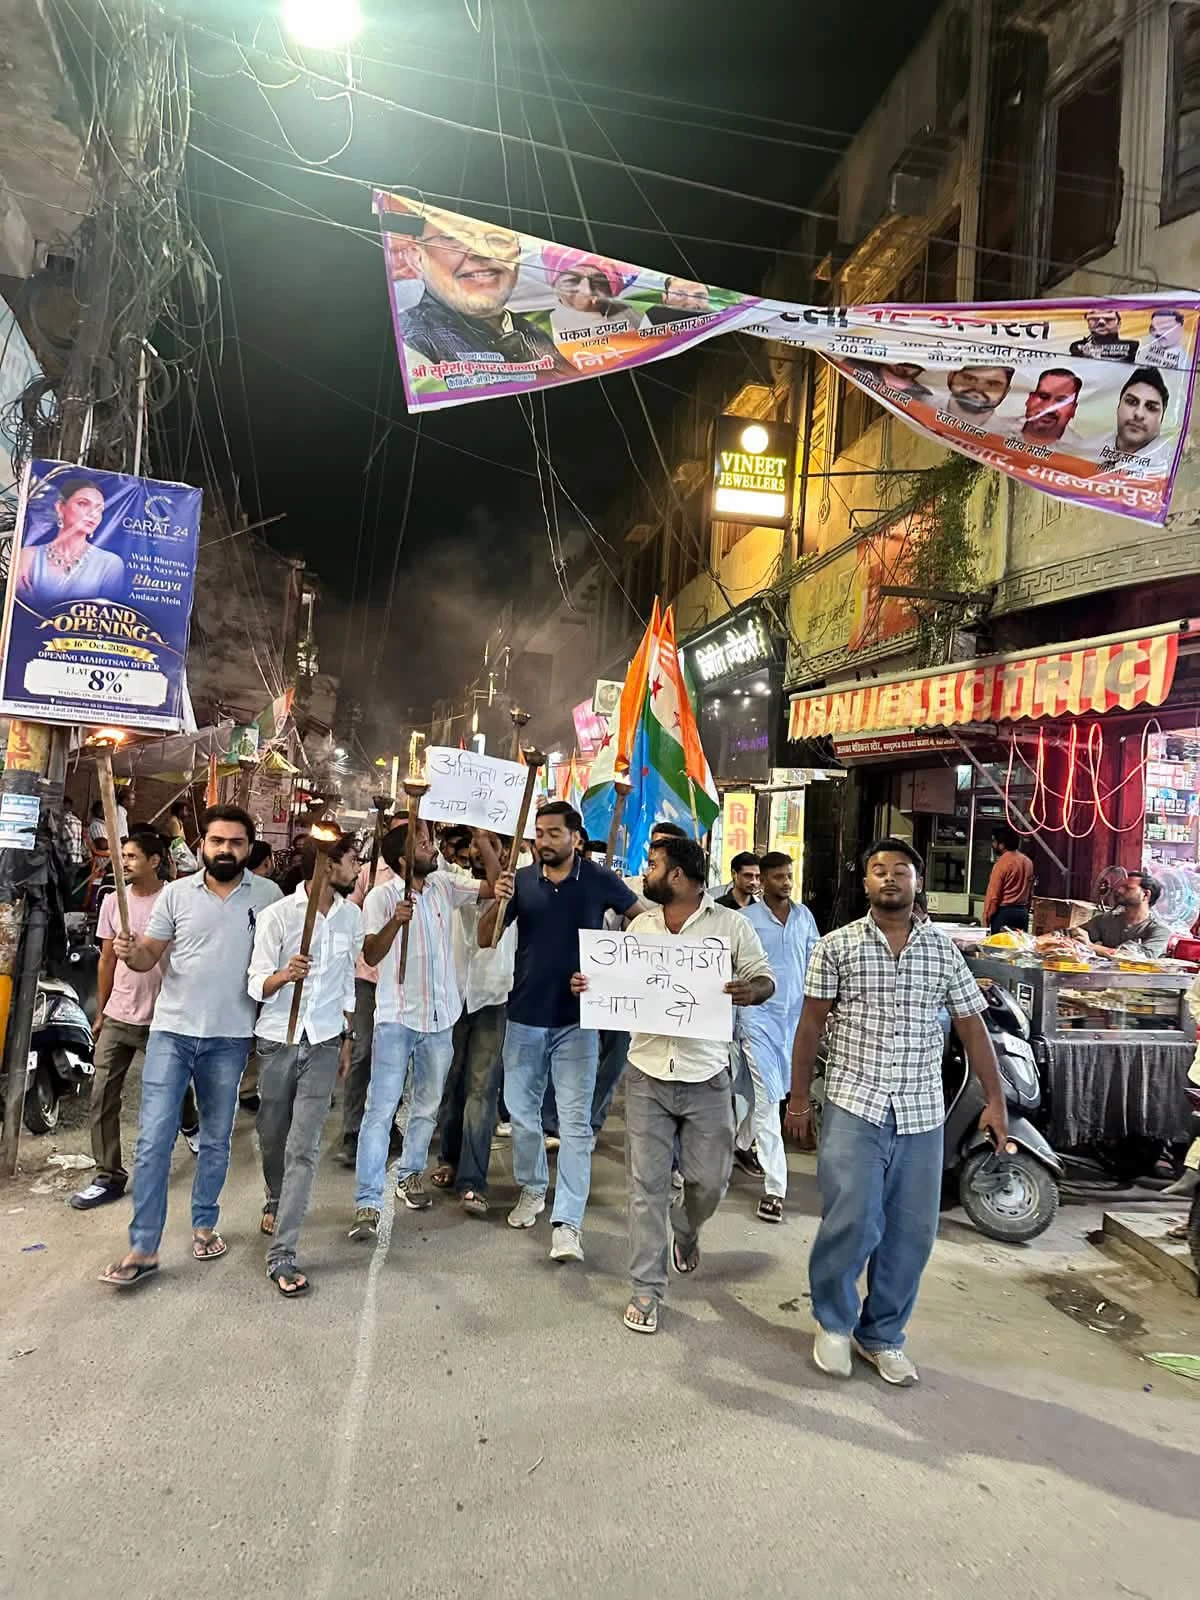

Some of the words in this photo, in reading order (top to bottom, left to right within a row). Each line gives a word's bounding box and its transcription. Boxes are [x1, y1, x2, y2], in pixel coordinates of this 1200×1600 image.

[560, 327, 592, 341] पंकज
[595, 320, 629, 337] टण्डन
[639, 325, 666, 338] कमल
[430, 360, 461, 378] सुरेश
[936, 409, 958, 427] रजत
[721, 452, 787, 477] VINEET
[719, 471, 786, 492] JEWELLERS
[122, 517, 170, 535] CARAT
[173, 526, 189, 537] 24
[141, 563, 151, 571] Ek
[153, 565, 173, 575] Naye
[132, 574, 182, 592] Bhavya
[160, 596, 181, 606] Mein
[70, 603, 137, 624] GRAND
[53, 616, 150, 642] OPENING
[38, 651, 78, 661] OPENING
[131, 660, 160, 671] OFFER
[65, 666, 89, 676] FLAT
[646, 964, 673, 989] को
